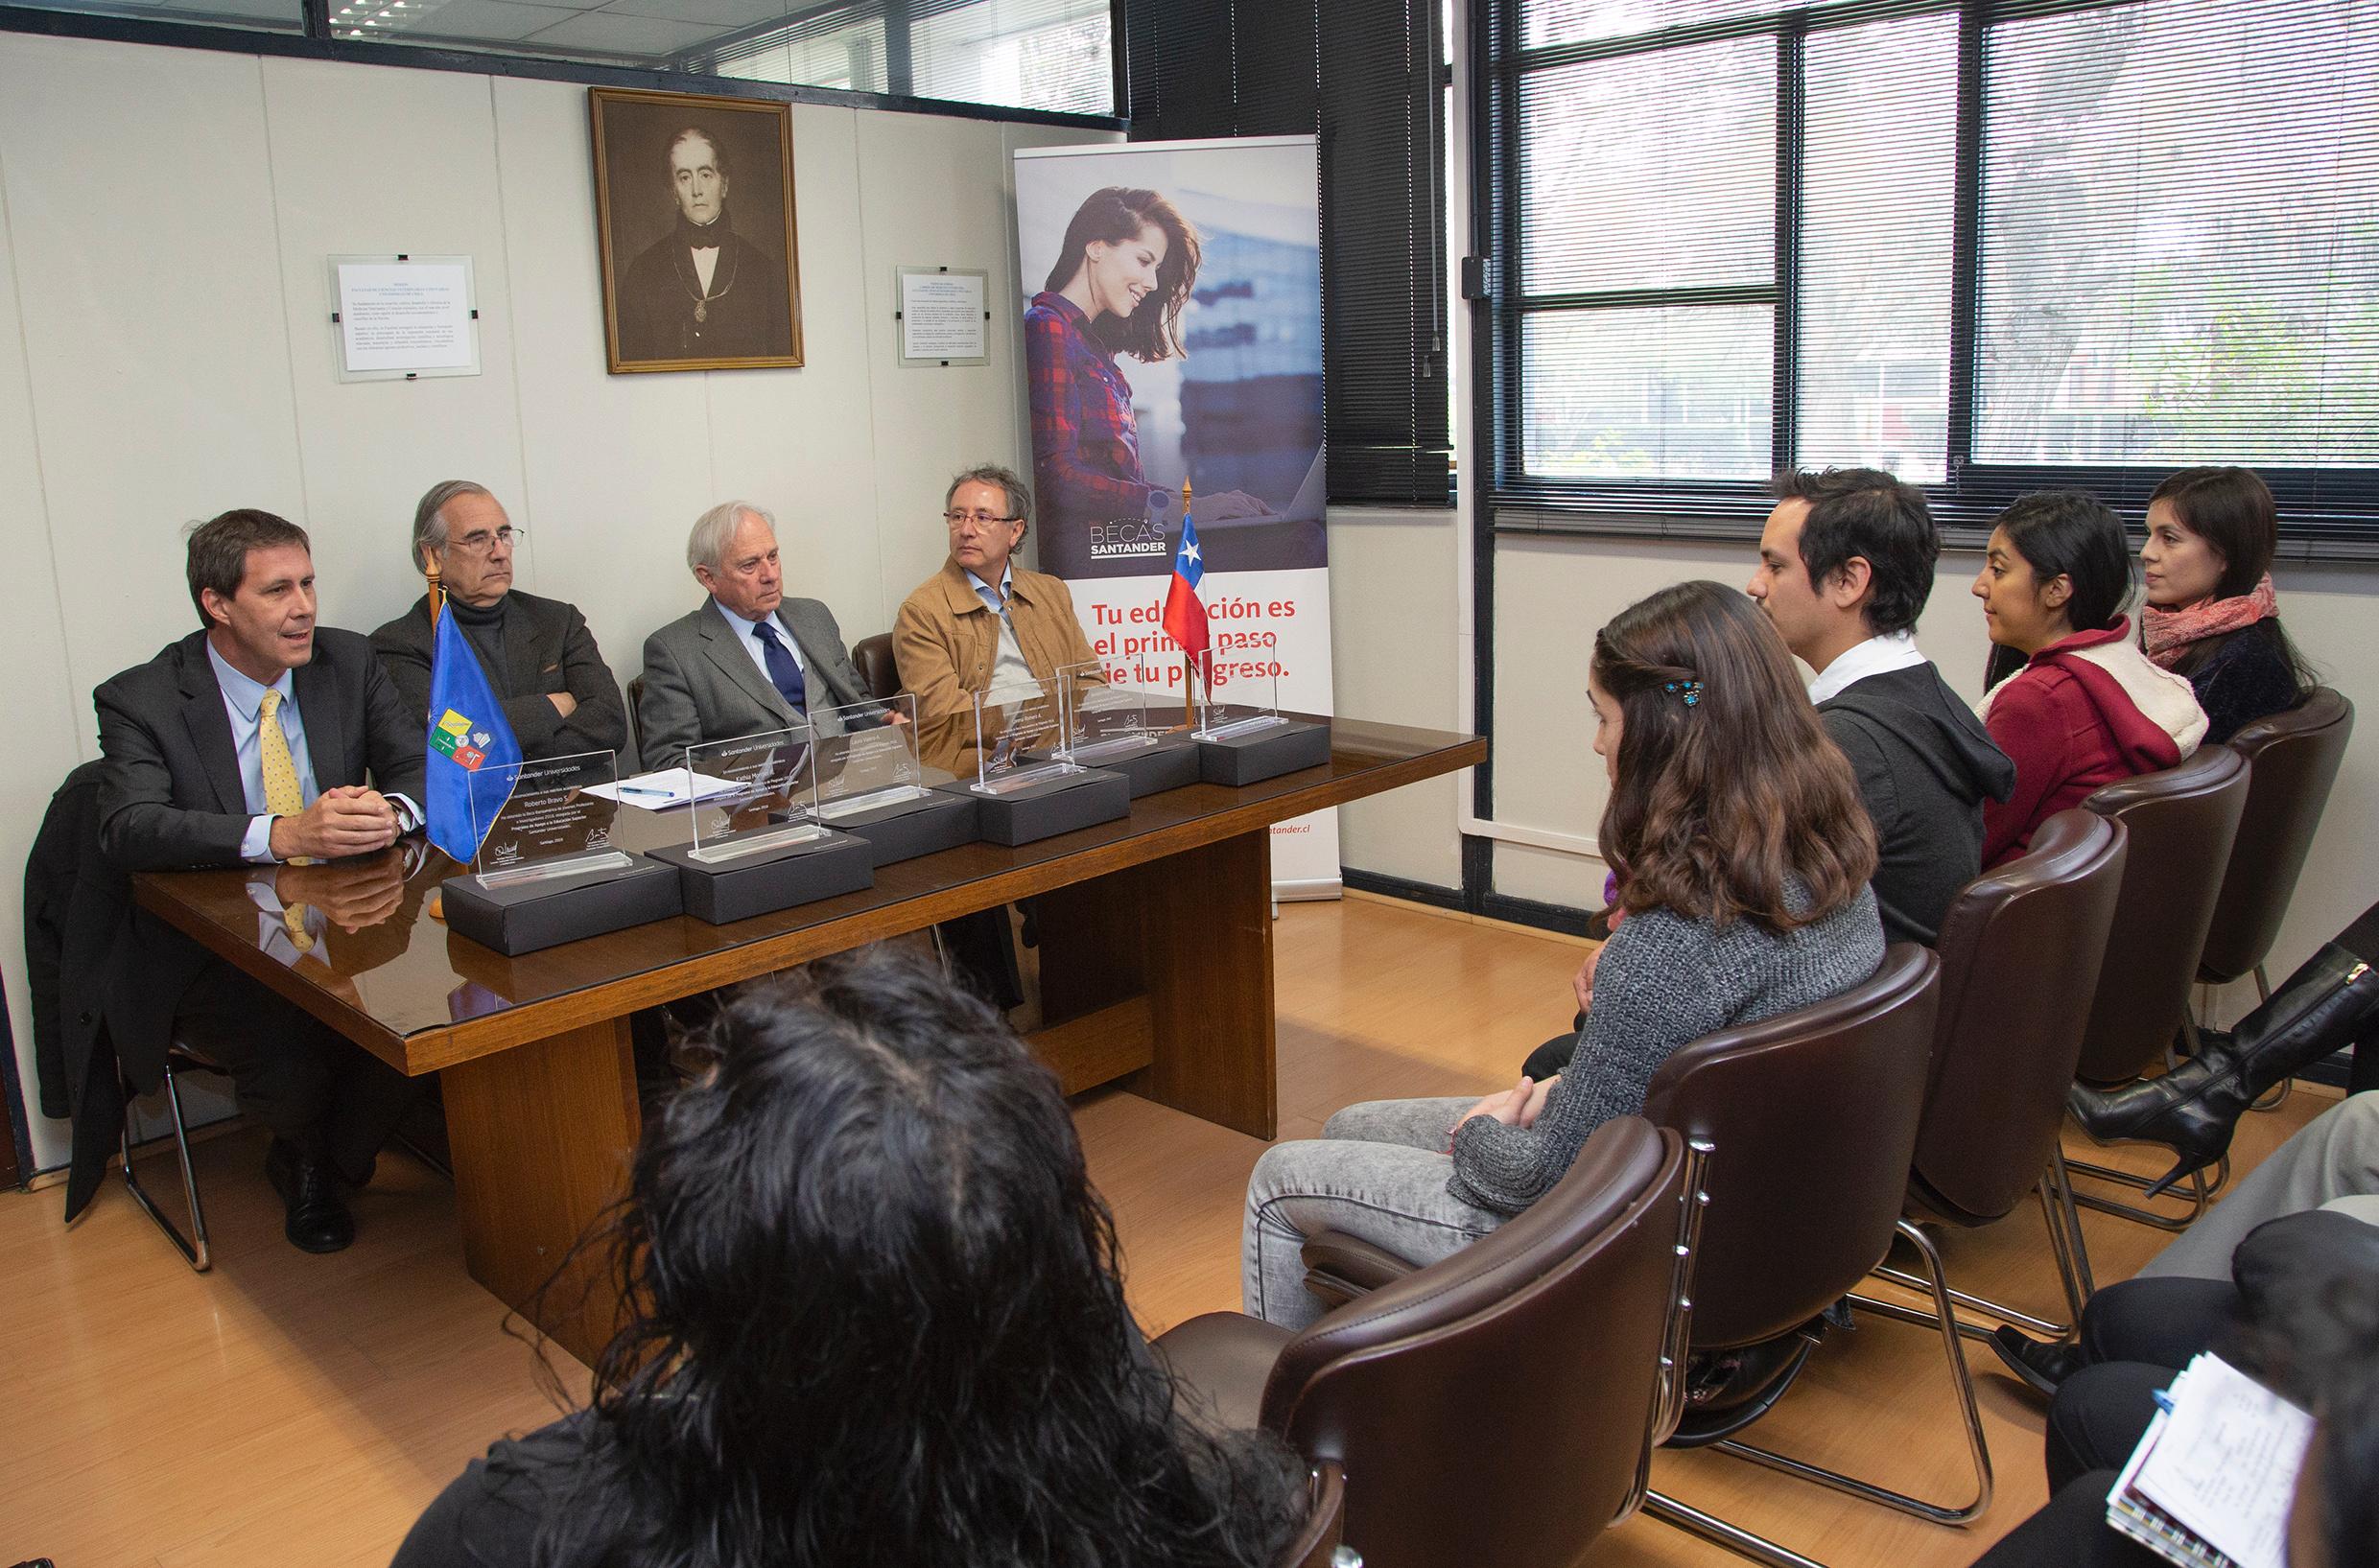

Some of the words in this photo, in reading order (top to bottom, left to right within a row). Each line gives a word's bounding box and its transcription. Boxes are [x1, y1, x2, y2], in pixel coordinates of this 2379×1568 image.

[1090, 523, 1166, 544] BECAS
[1091, 541, 1166, 555] SANTANDER
[1091, 603, 1122, 625] Tu
[1129, 597, 1260, 622] edción
[1267, 599, 1296, 618] es
[1094, 632, 1116, 656] el
[1123, 630, 1211, 660] prim
[1217, 631, 1277, 655] paso
[1104, 663, 1128, 684] e
[1133, 663, 1160, 683] tu
[1167, 661, 1290, 688] pgreso.
[727, 745, 752, 756] Santander
[752, 739, 785, 752] Universidades
[514, 770, 544, 782] Santander
[543, 764, 581, 777] Universidades
[524, 797, 547, 808] Roberto
[547, 796, 564, 806] Bravo
